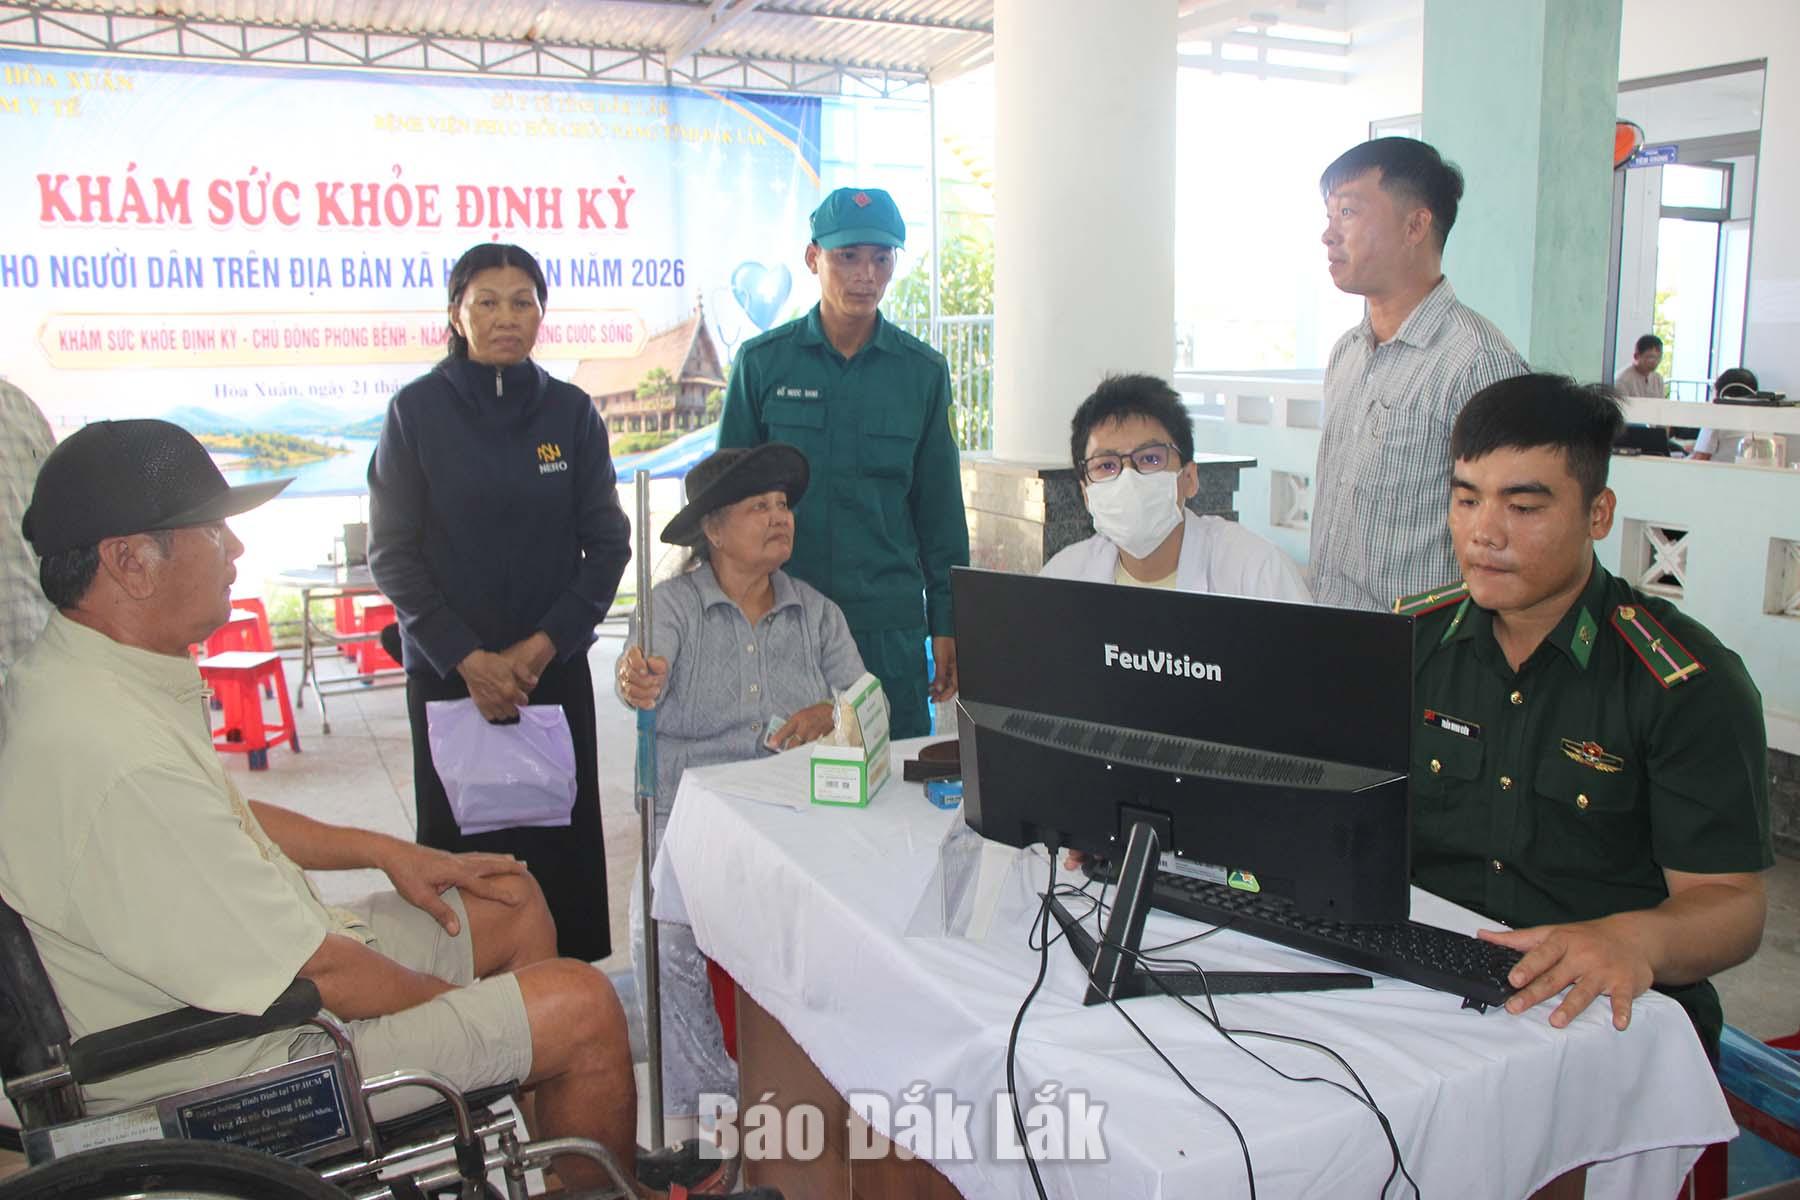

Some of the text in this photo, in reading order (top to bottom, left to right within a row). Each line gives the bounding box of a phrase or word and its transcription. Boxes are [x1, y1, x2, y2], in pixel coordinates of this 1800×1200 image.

[37, 161, 637, 241] KHÁM SỨC KHỎE ĐỊNH KỲ
[0, 254, 39, 288] HO
[50, 247, 137, 288] NGƯỜI
[147, 249, 204, 288] DÂN
[212, 249, 280, 288] TRÊN
[289, 257, 333, 296] ĐỊA
[341, 250, 392, 288] BÀN
[401, 250, 434, 288] XÃ
[570, 251, 622, 287] NĂM
[631, 258, 685, 287] 2026
[59, 321, 102, 351] KHÁM
[1104, 643, 1222, 682] FeuVision
